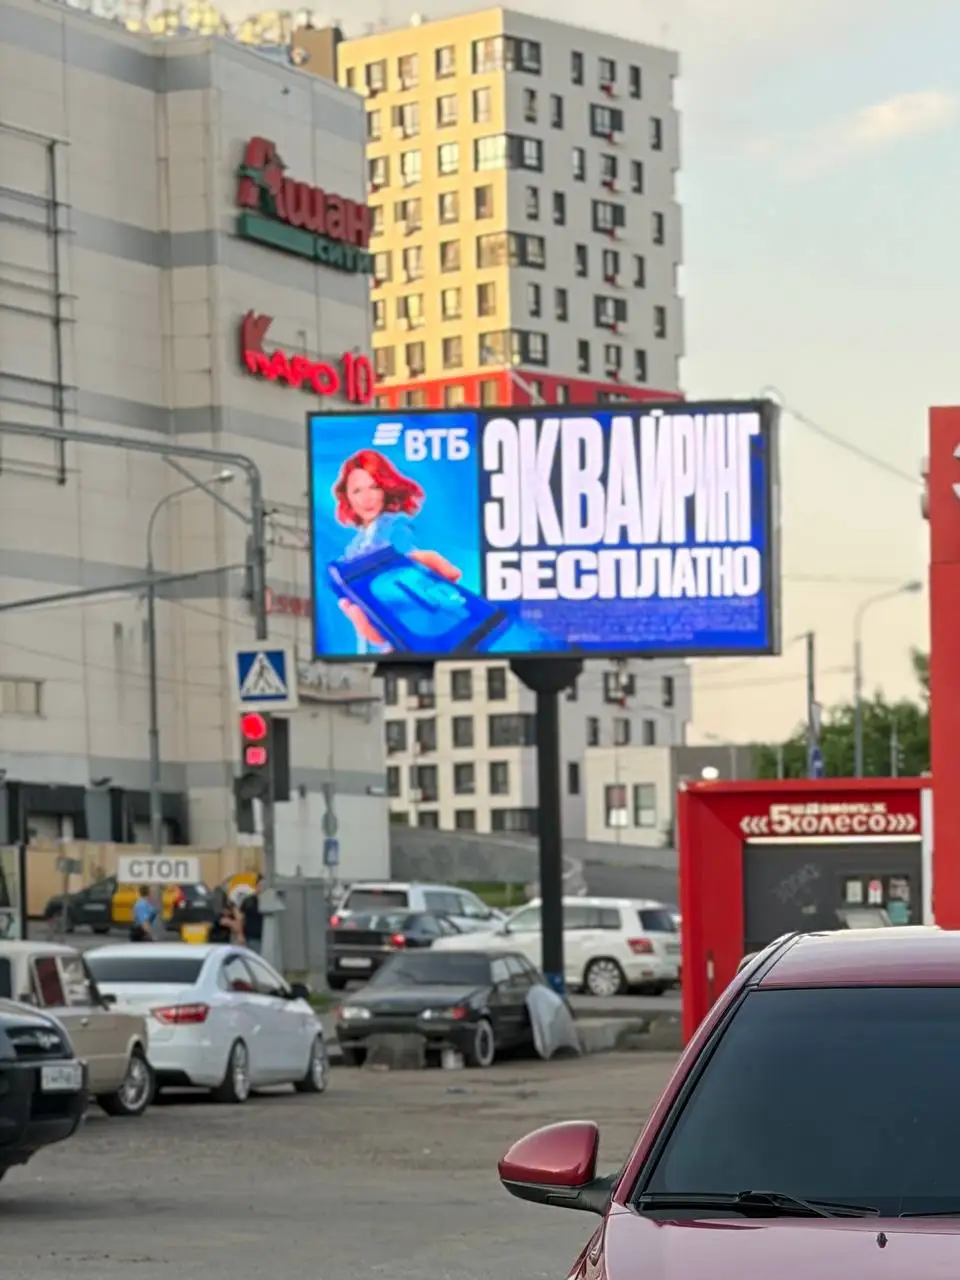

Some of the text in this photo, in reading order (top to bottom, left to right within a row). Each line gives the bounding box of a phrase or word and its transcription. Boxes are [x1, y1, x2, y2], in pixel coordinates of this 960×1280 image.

[342, 351, 374, 404] 10
[404, 427, 470, 462] ВТБ
[482, 409, 760, 548] ЭКВАЙРИНГ
[485, 546, 761, 601] БЕСПЛАТНО
[128, 860, 189, 878] СТОП
